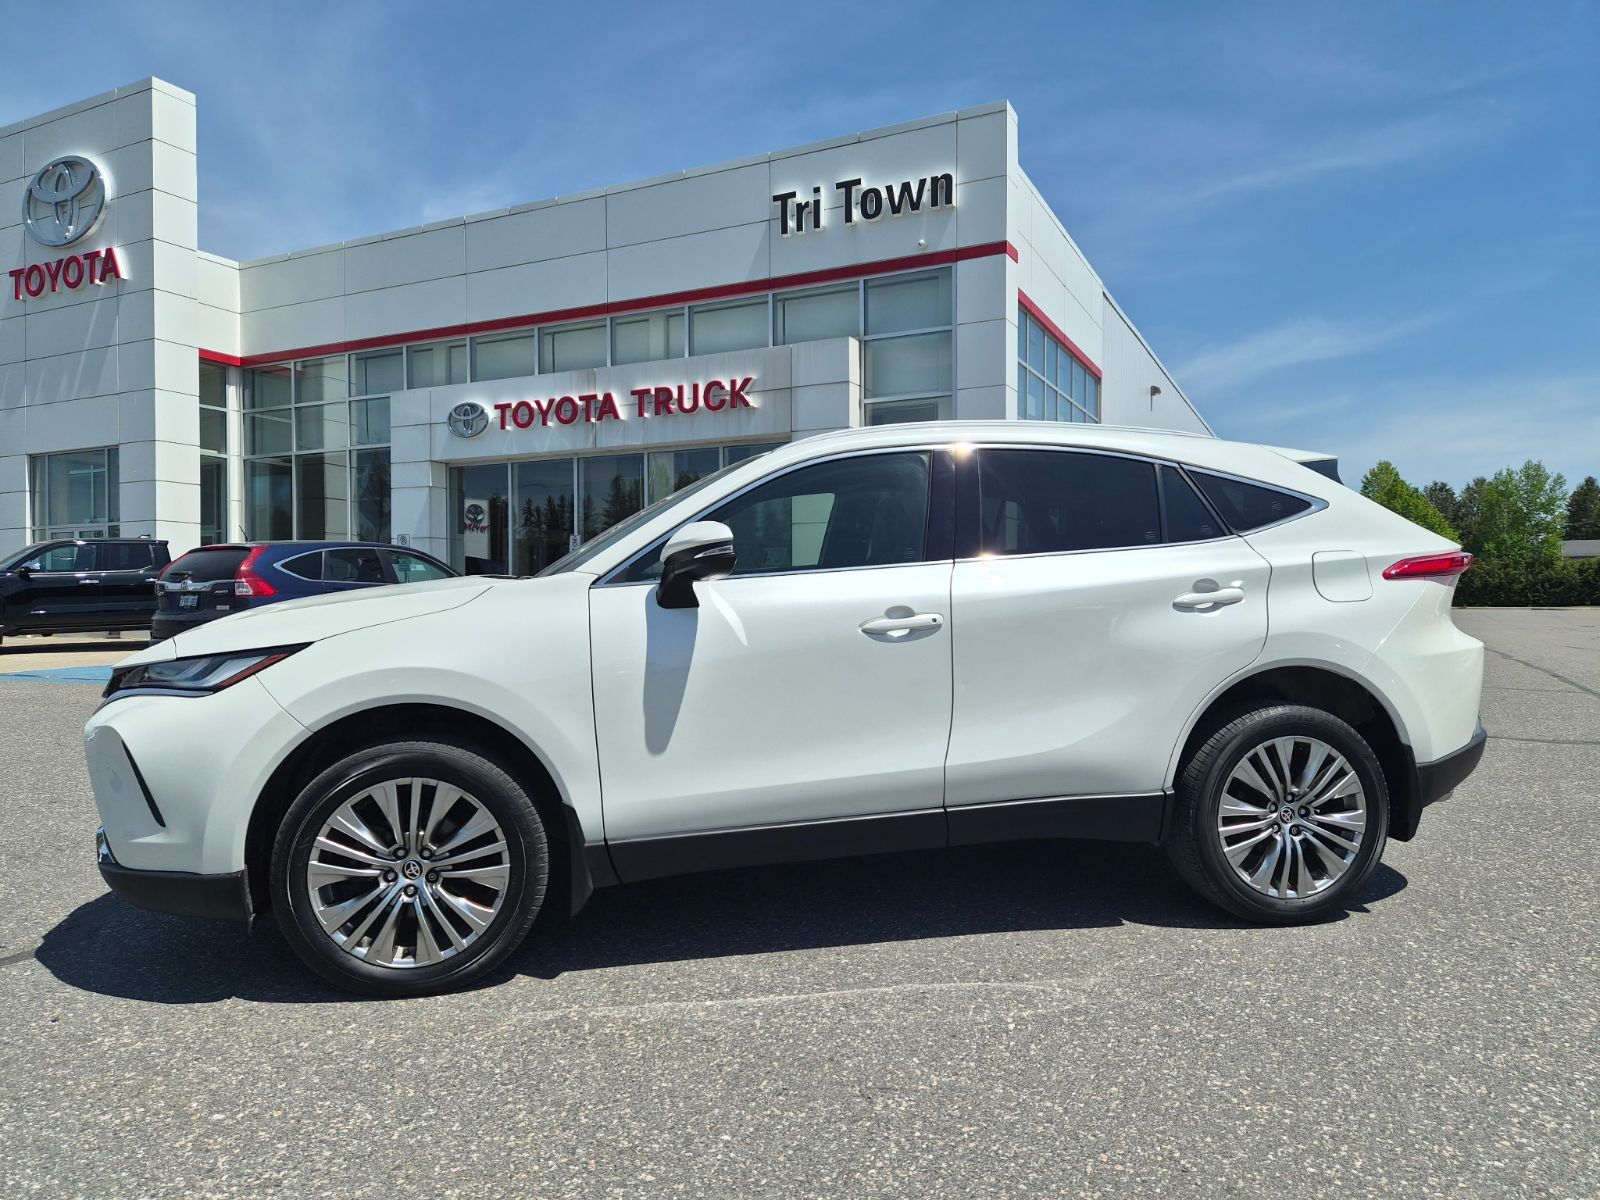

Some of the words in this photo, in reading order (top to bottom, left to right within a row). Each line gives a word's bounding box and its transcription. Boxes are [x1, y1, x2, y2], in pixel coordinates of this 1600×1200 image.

[773, 186, 821, 235] Tri
[836, 173, 953, 223] Town
[9, 247, 121, 300] TOYOTA
[494, 392, 620, 430] TOYOTA
[631, 377, 753, 417] TRUCK
